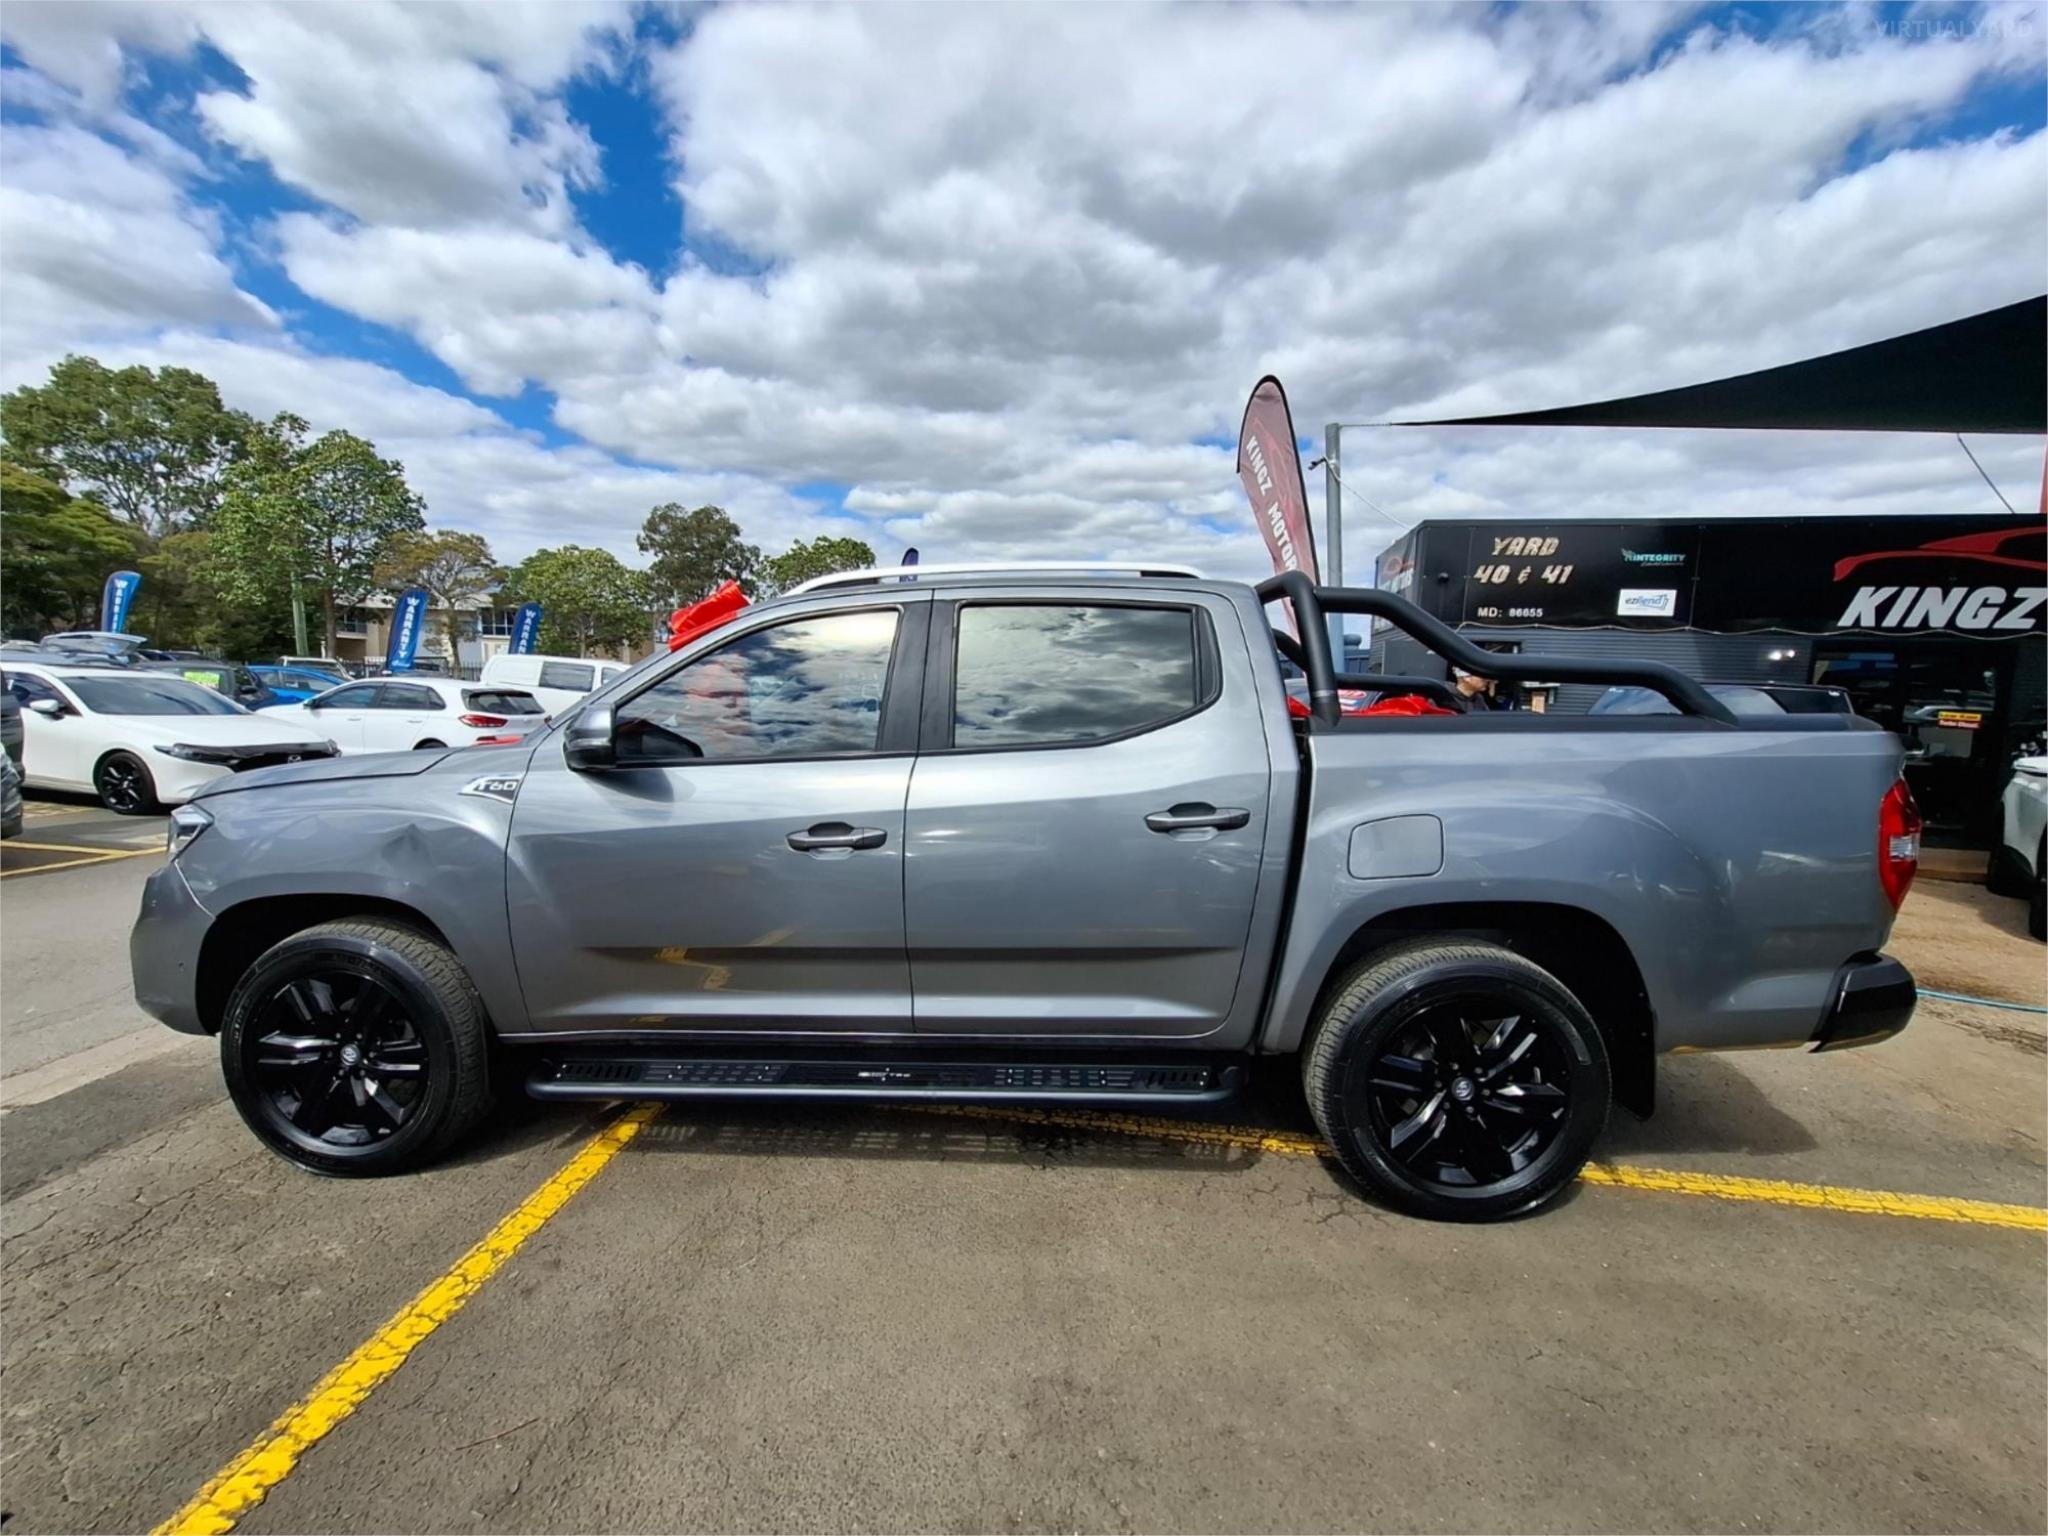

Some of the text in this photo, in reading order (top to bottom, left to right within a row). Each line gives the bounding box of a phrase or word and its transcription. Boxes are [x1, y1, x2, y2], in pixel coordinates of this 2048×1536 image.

[1246, 435, 1298, 571] KINGZ MOTOR
[1491, 536, 1560, 556] YARD
[1632, 552, 1686, 562] INTEGRITY
[1473, 565, 1511, 584] 40
[1541, 565, 1574, 584] 41
[1477, 606, 1503, 618] MD:
[1836, 586, 2047, 629] KINGZ
[398, 597, 420, 659] WARRANTY
[477, 781, 519, 791] T60
